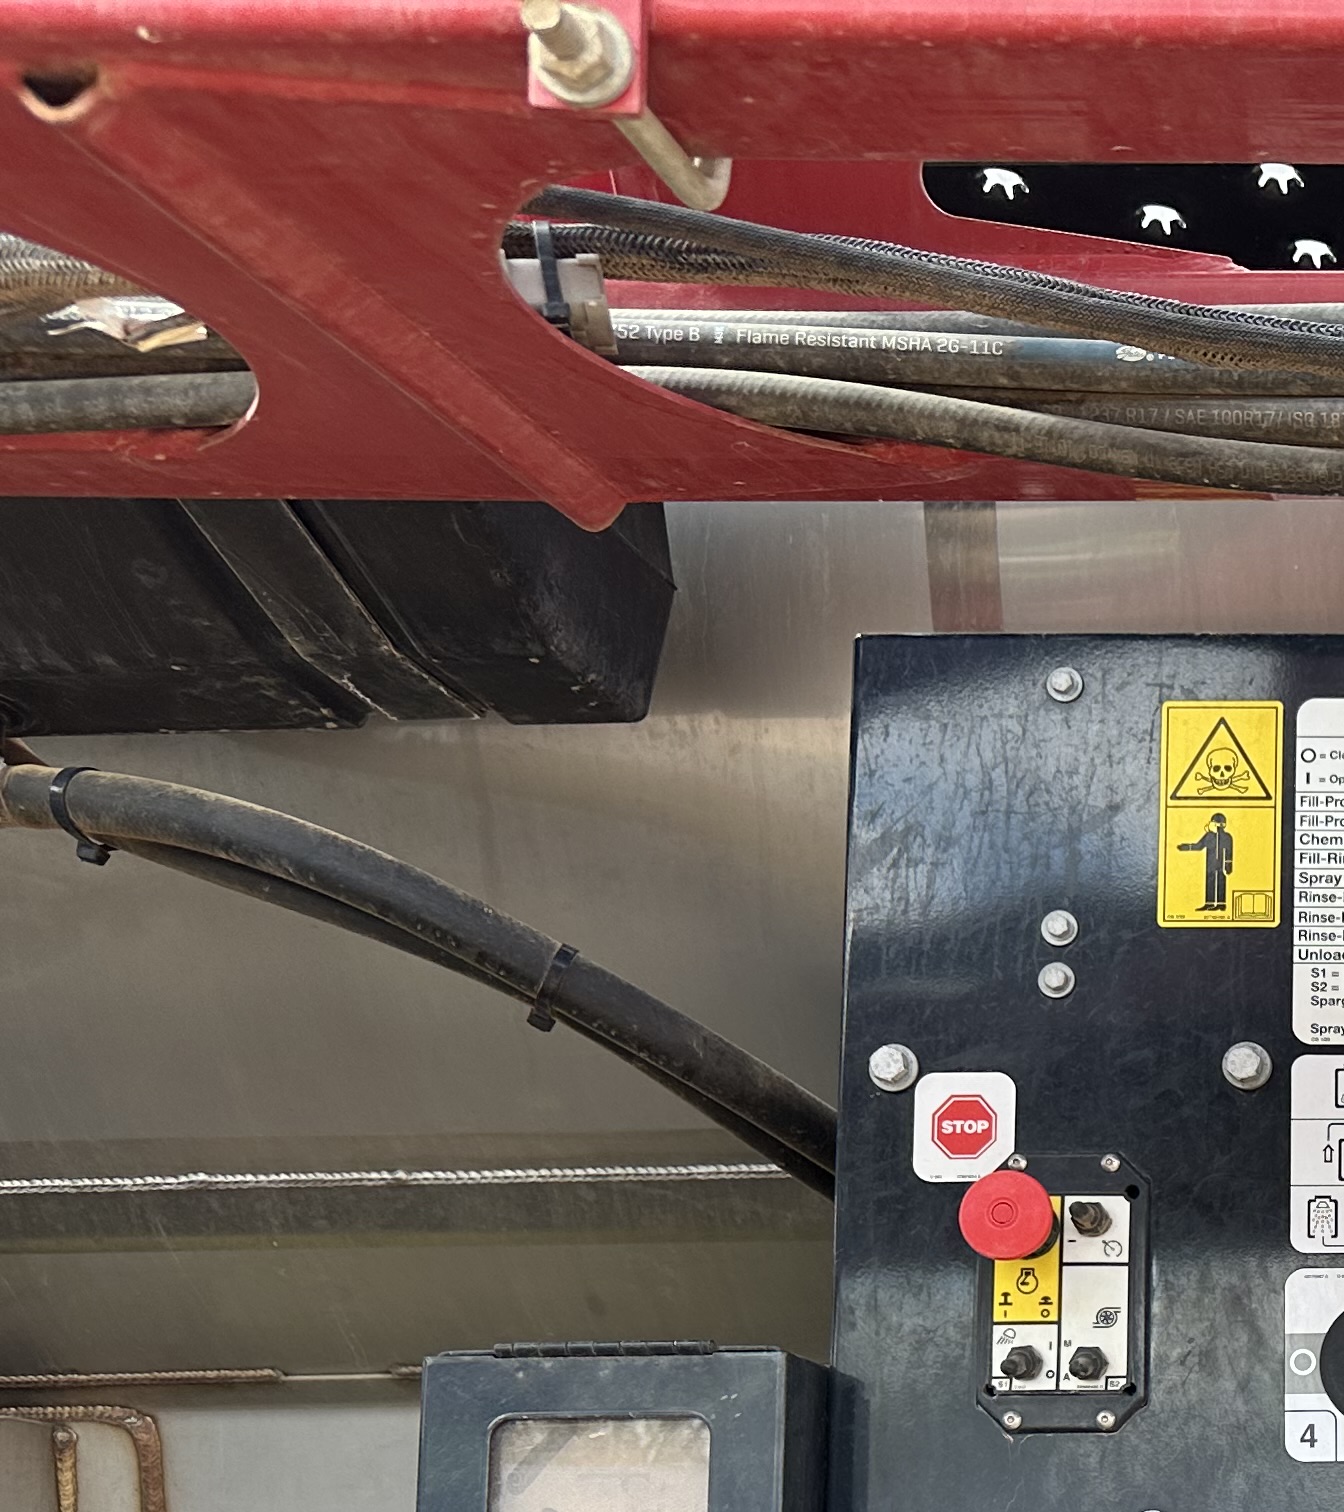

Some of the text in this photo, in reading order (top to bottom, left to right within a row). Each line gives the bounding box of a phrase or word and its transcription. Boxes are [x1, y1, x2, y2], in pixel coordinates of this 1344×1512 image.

[645, 325, 700, 344] Type B
[736, 328, 1003, 356] Flame Resistant MSHA 2G-11C
[1299, 872, 1342, 887] Spray
[1311, 968, 1326, 980] S1
[941, 1120, 989, 1134] STOP
[1300, 1423, 1318, 1449] 4
